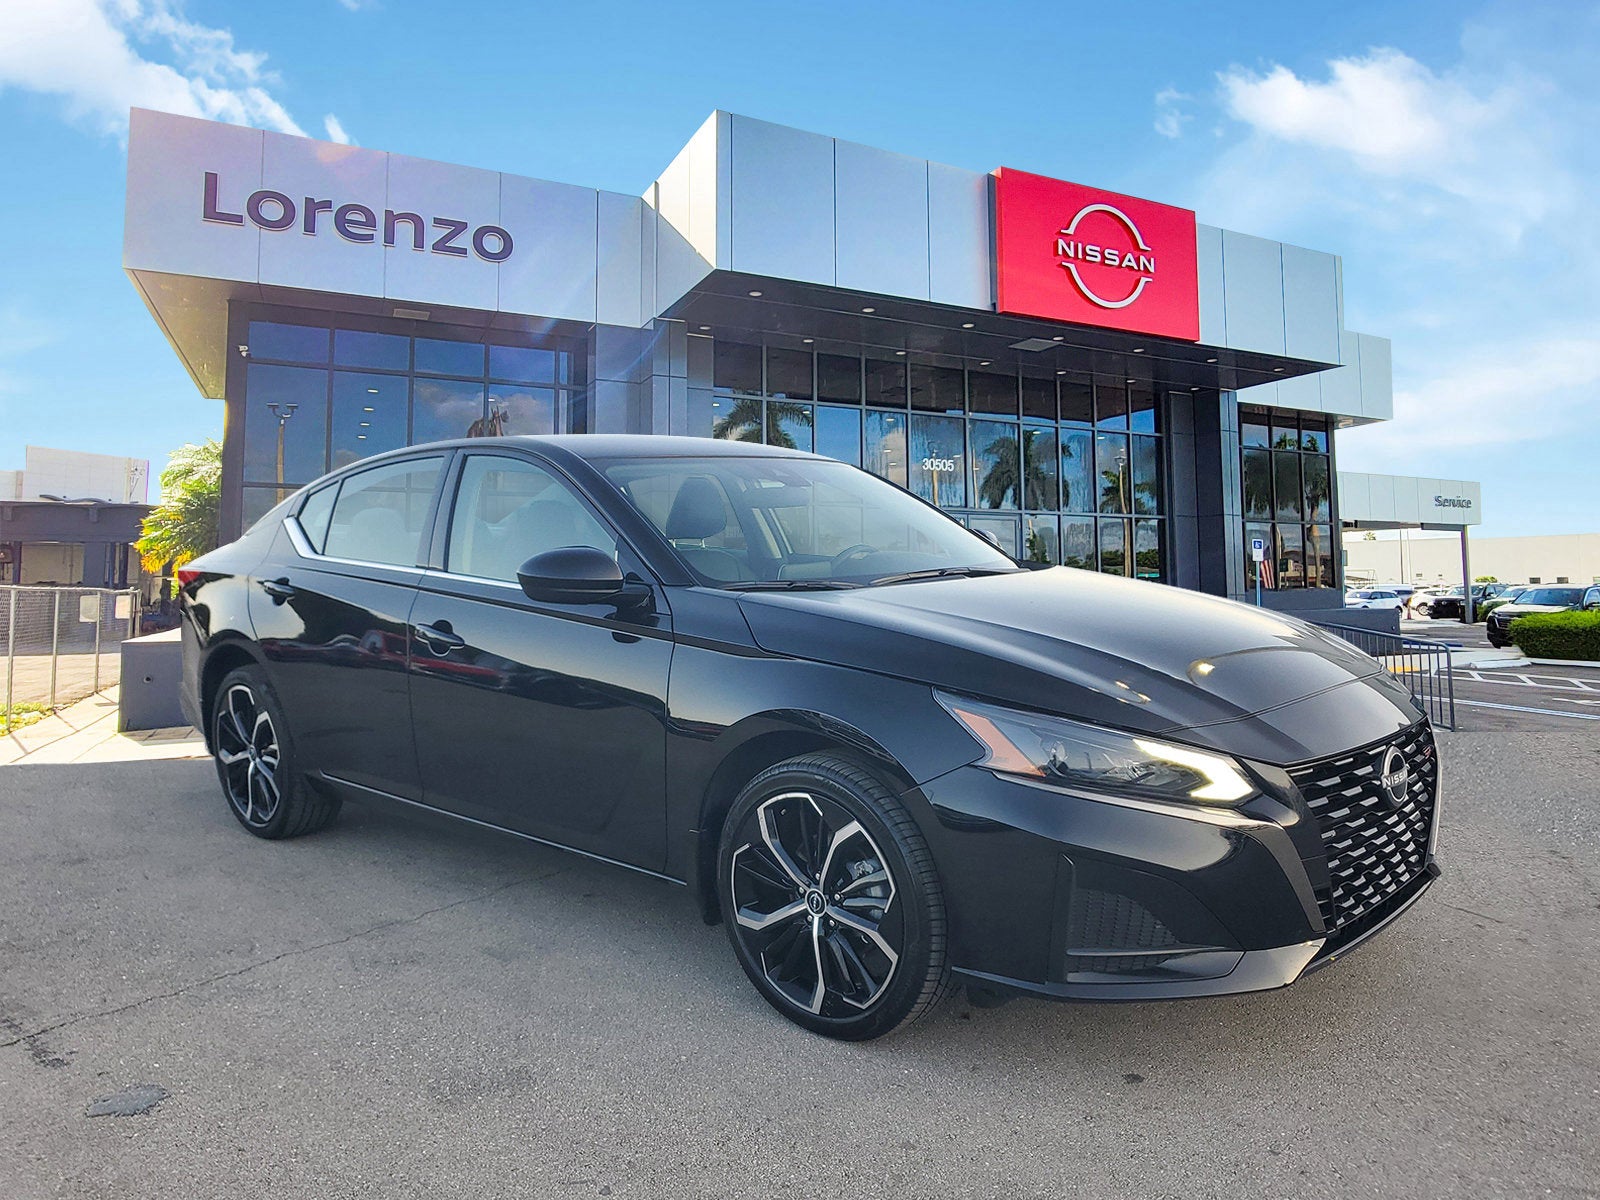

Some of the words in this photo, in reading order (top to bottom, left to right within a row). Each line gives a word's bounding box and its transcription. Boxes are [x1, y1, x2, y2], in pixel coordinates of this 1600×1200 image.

[202, 171, 514, 262] Lorenzo
[1057, 238, 1155, 273] NISSAN
[922, 458, 955, 472] 30505
[1434, 495, 1472, 509] Service
